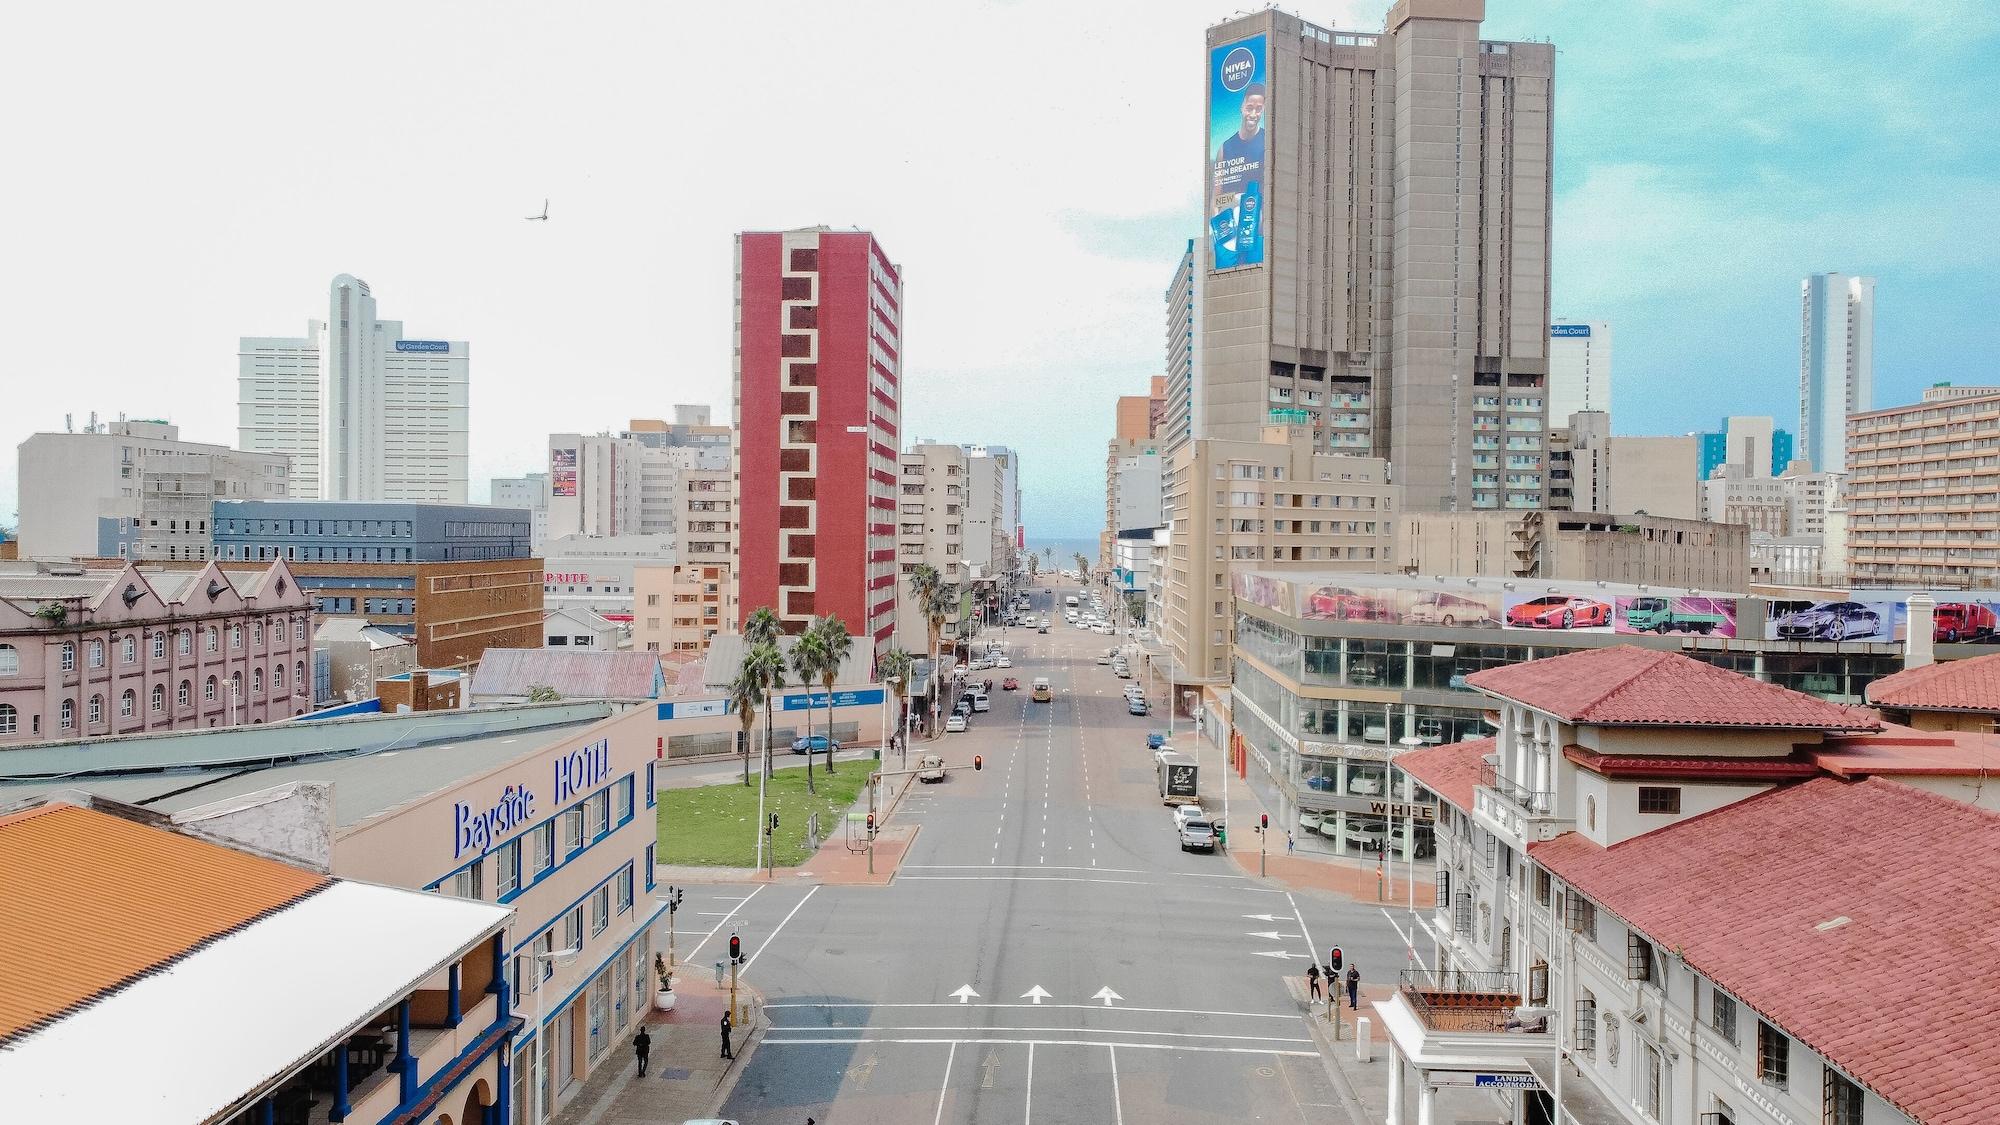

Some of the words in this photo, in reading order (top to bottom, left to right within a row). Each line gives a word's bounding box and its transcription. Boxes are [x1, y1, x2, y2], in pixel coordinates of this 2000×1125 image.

[1225, 60, 1251, 75] NIVEA
[1228, 70, 1248, 82] MEN
[1214, 161, 1226, 170] LET
[1226, 156, 1245, 167] YOUR
[1214, 168, 1229, 178] SKIN
[1230, 161, 1260, 175] BREATHE
[1216, 194, 1234, 206] NEW
[405, 342, 430, 350] Garden
[454, 783, 536, 859] Bayside
[554, 738, 613, 806] HOTEL
